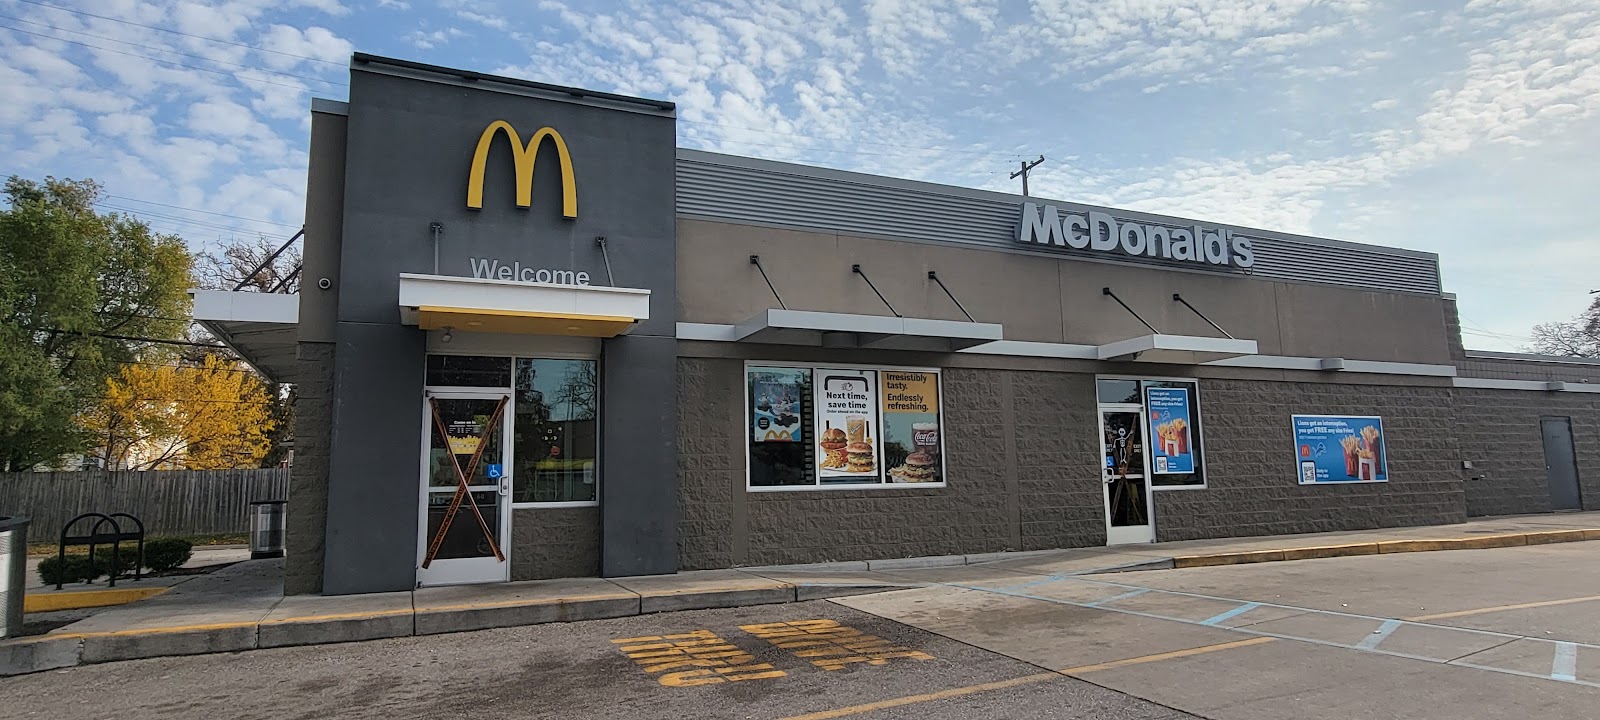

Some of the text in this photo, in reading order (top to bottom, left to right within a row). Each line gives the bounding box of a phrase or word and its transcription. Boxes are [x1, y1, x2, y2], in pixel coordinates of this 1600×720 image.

[1019, 202, 1254, 268] McDonald's
[470, 257, 590, 286] Welcome
[886, 373, 927, 384] Irresistibly
[887, 381, 908, 391] tasty.
[826, 391, 868, 401] Next time,
[887, 393, 923, 403] Endlessly
[848, 401, 867, 409] time
[887, 402, 929, 412] refreshing.
[610, 629, 788, 687] THRU
